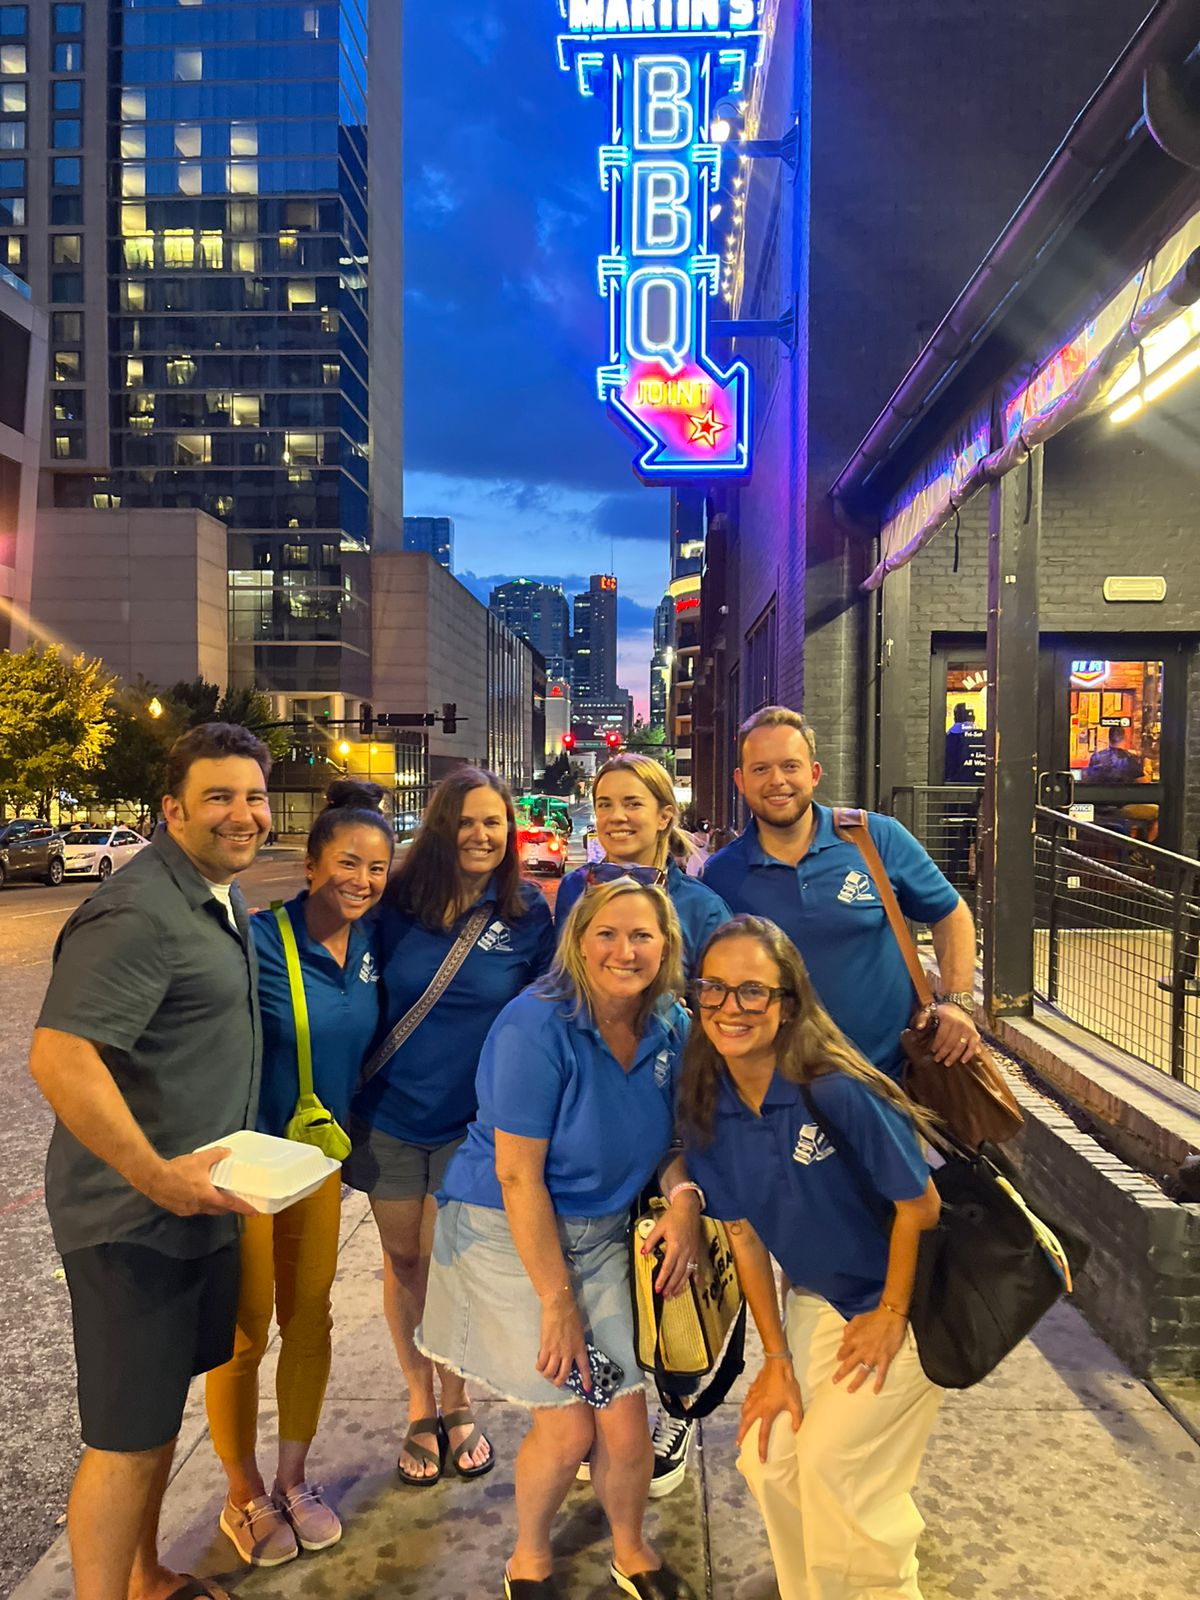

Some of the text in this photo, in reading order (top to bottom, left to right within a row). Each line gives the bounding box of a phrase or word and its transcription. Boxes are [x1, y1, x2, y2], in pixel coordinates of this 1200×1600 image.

[569, 0, 754, 33] MARTINS
[626, 55, 693, 374] BBQ
[634, 380, 711, 405] JOINT
